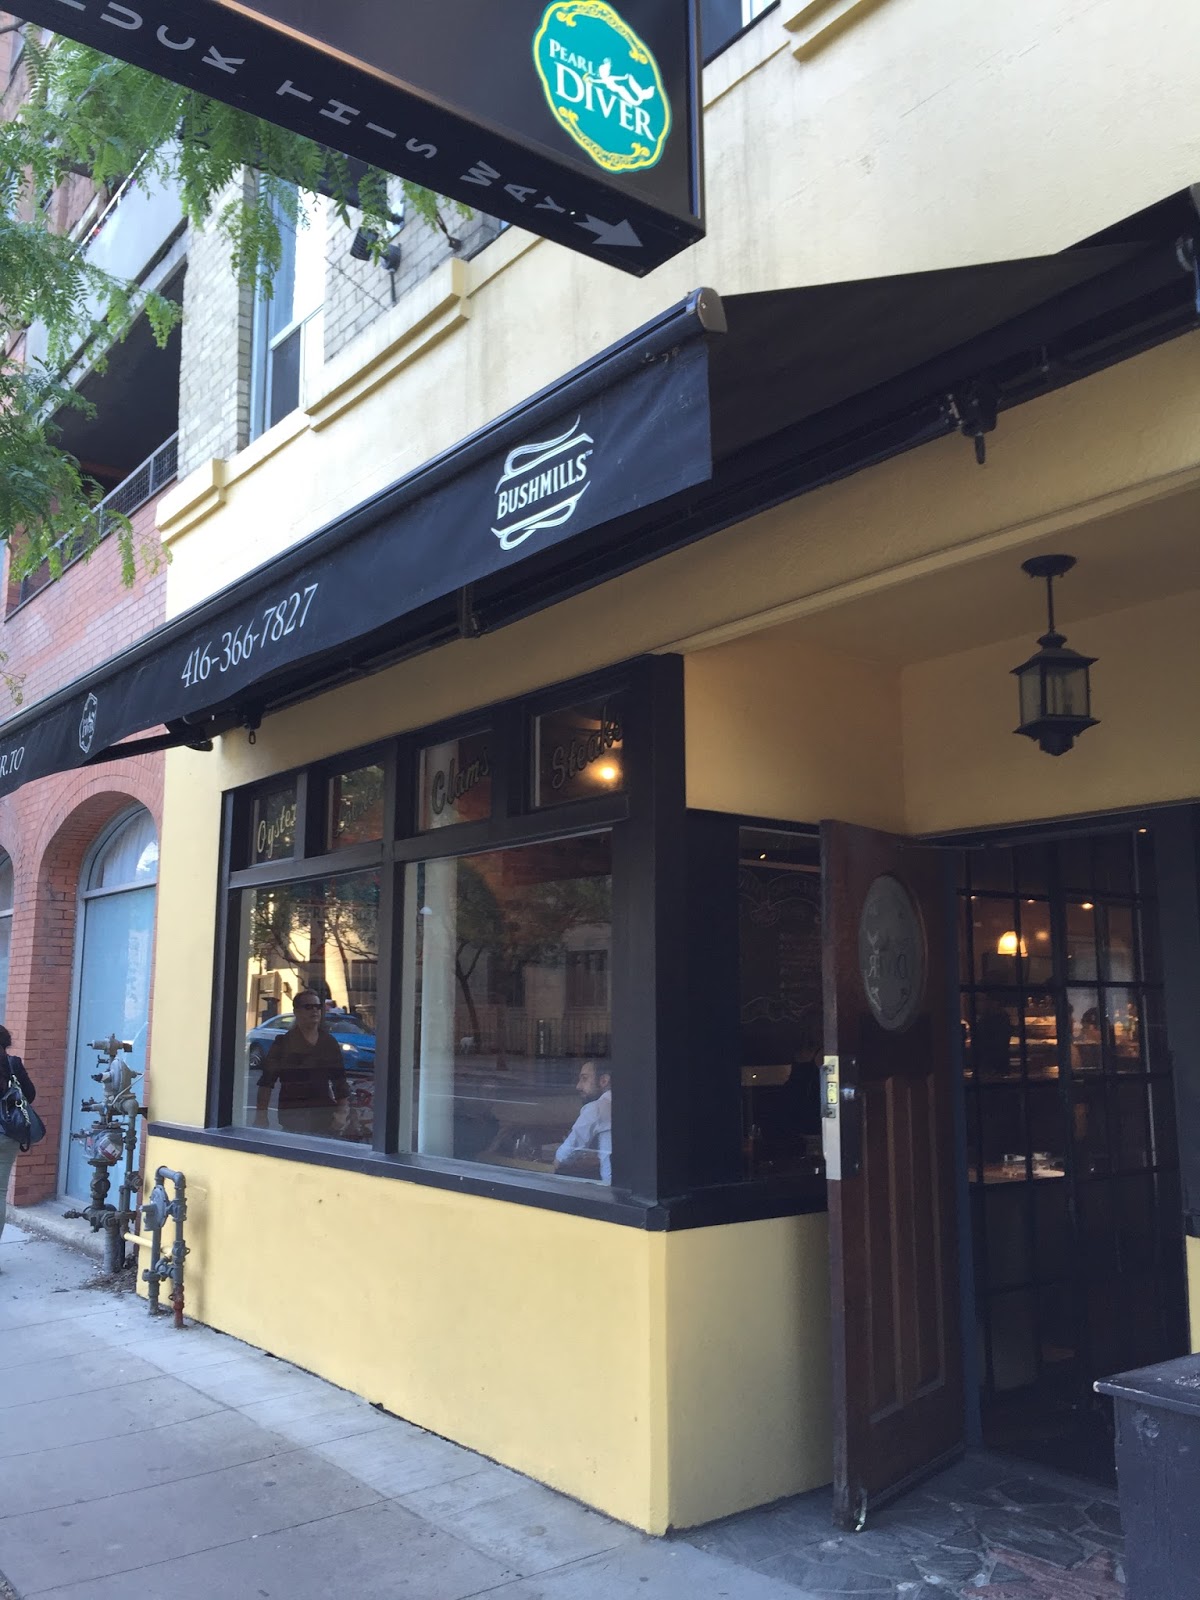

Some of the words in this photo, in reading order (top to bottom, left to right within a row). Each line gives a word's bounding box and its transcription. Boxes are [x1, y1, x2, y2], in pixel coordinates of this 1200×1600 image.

[549, 38, 597, 77] PEARL
[554, 61, 656, 142] DIVER
[276, 80, 438, 159] THIS
[460, 160, 566, 214] WAY
[497, 452, 588, 520] BUSHMILLS
[181, 582, 319, 688] 416-366-7827
[0, 746, 25, 778] R.TO
[432, 746, 489, 815] Clams
